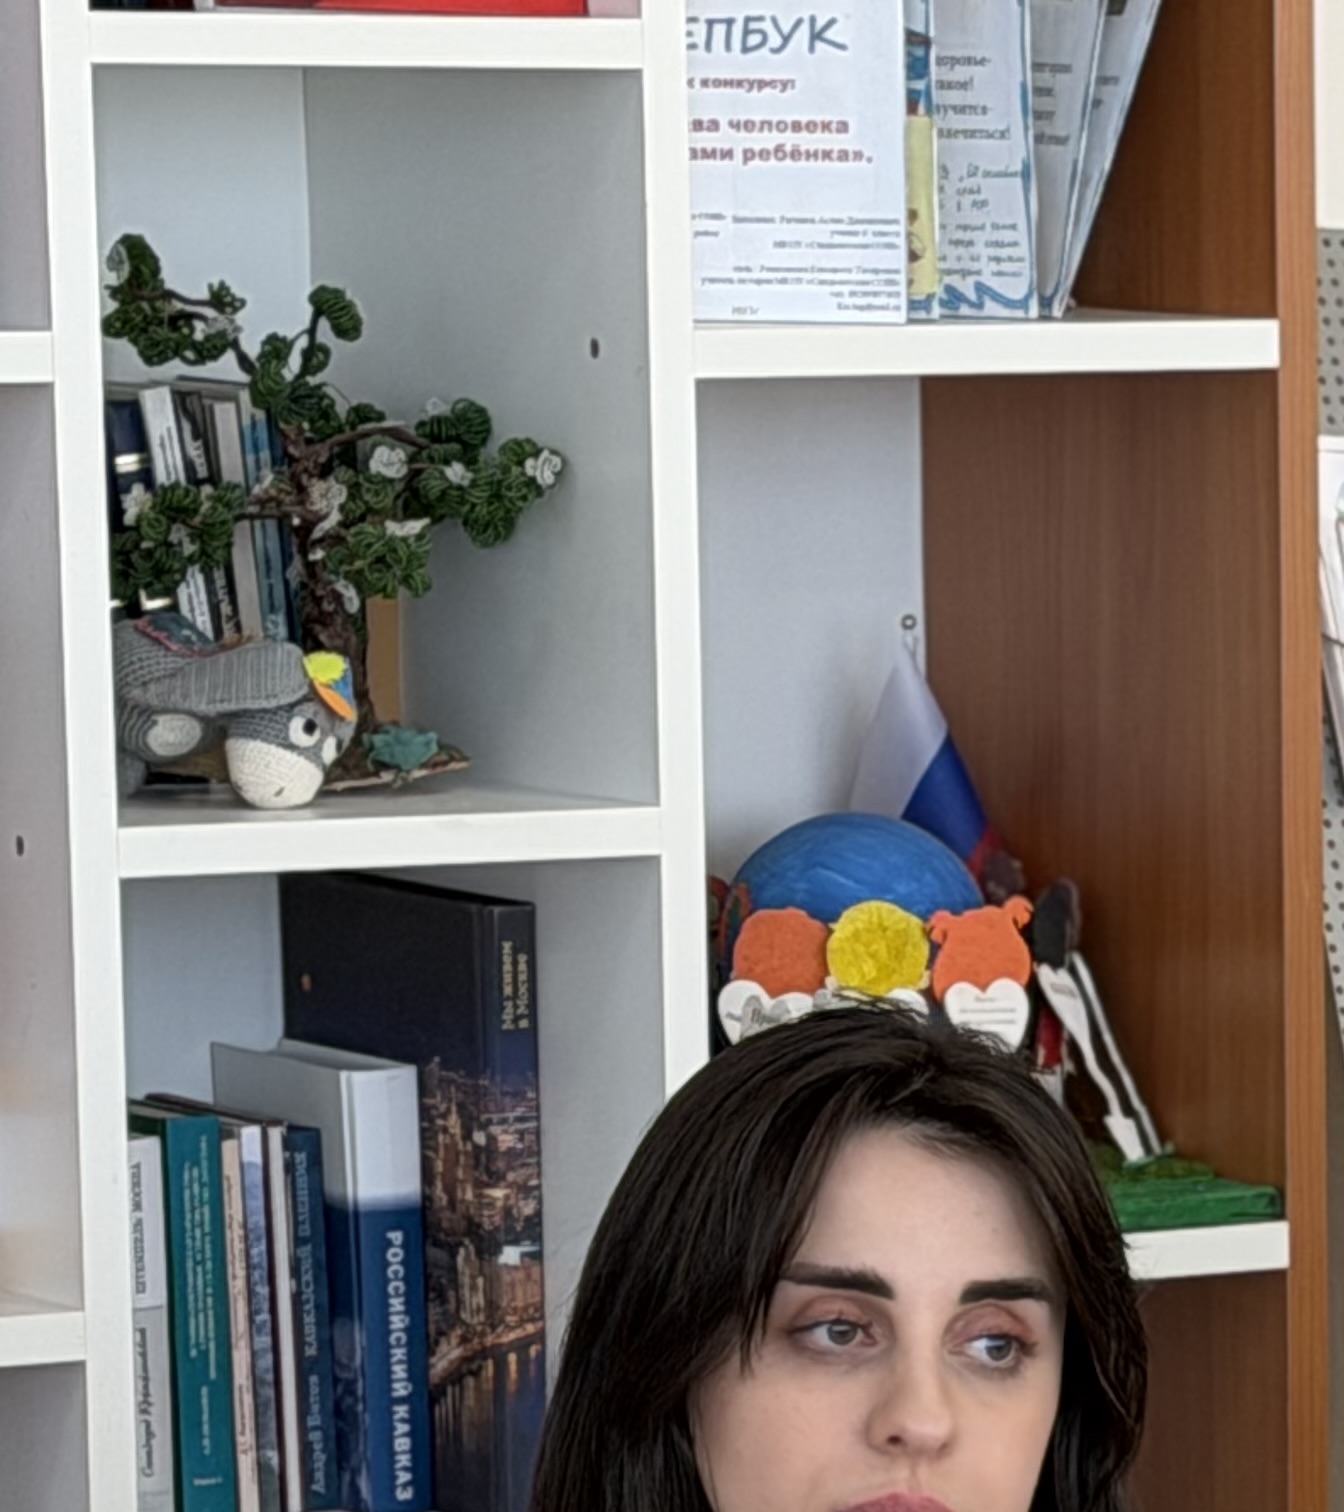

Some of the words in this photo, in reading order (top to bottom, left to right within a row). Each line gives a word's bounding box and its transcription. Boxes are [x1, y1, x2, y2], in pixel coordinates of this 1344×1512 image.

[700, 77, 796, 93] конкурсу:
[727, 119, 850, 134] человека
[742, 143, 873, 166] ребёнка».
[501, 1001, 515, 1030] Мы
[297, 1243, 317, 1357] КАВКАЗСКИЙ
[386, 1230, 413, 1397] РОССИЙСКИЙ
[308, 1430, 327, 1494] Андрей
[392, 1405, 414, 1501] КАВКАЗ
